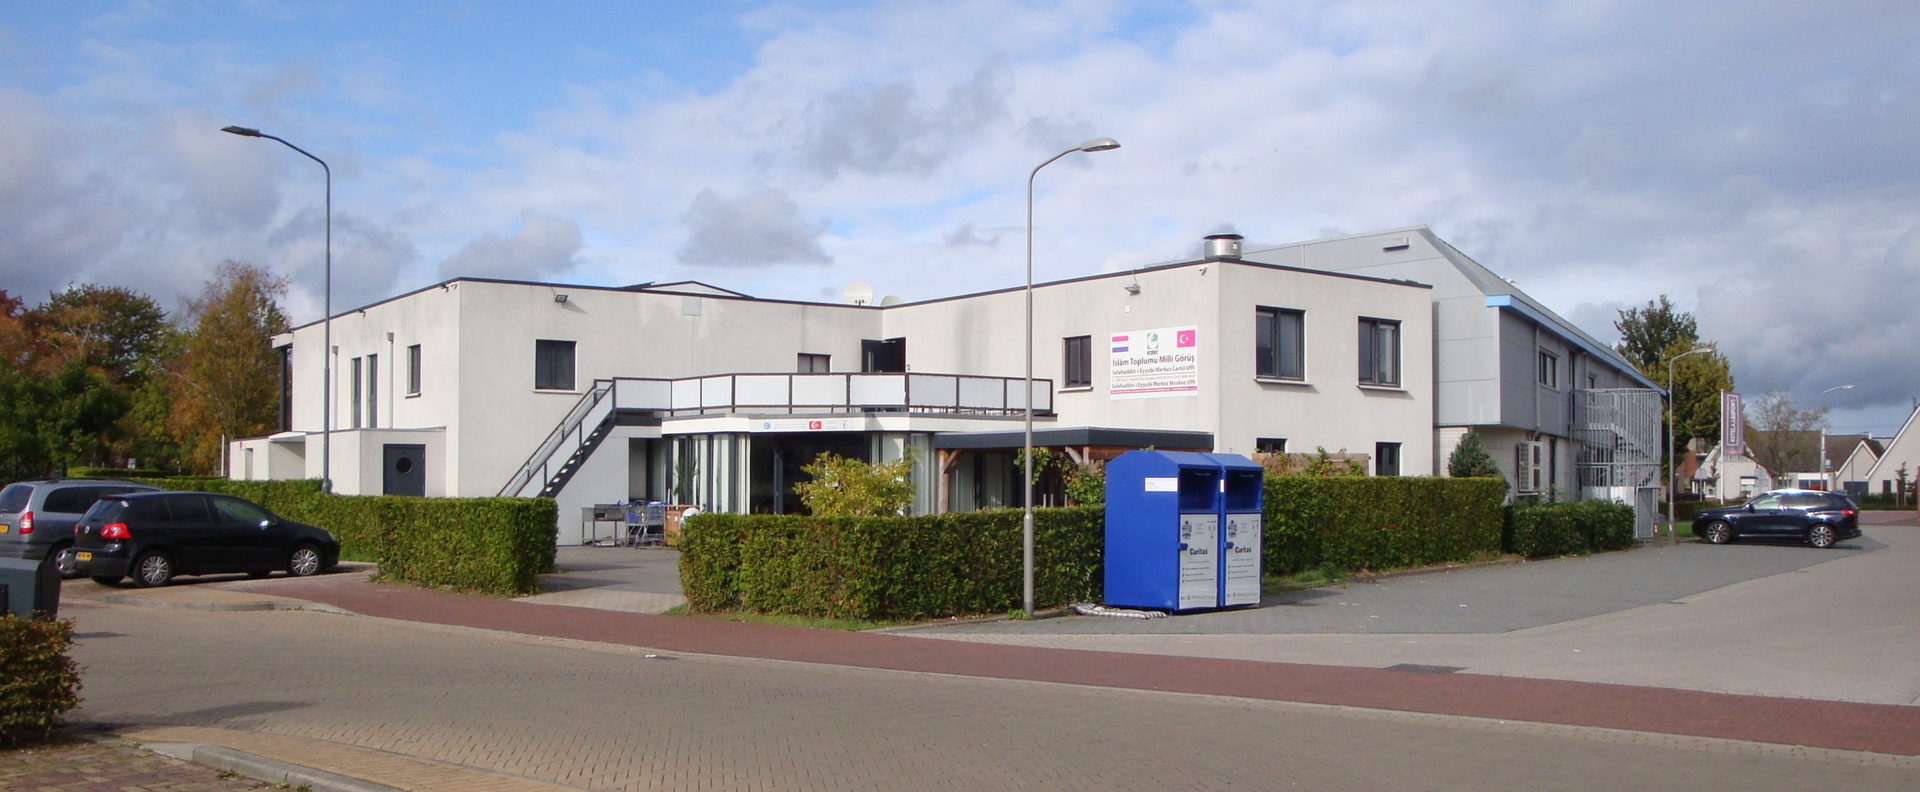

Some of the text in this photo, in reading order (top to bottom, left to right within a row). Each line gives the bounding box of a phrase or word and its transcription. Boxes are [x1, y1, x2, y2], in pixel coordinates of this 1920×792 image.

[1130, 357, 1158, 366] Toplumu
[1174, 354, 1194, 362] Görüş
[1190, 548, 1208, 556] Curitas
